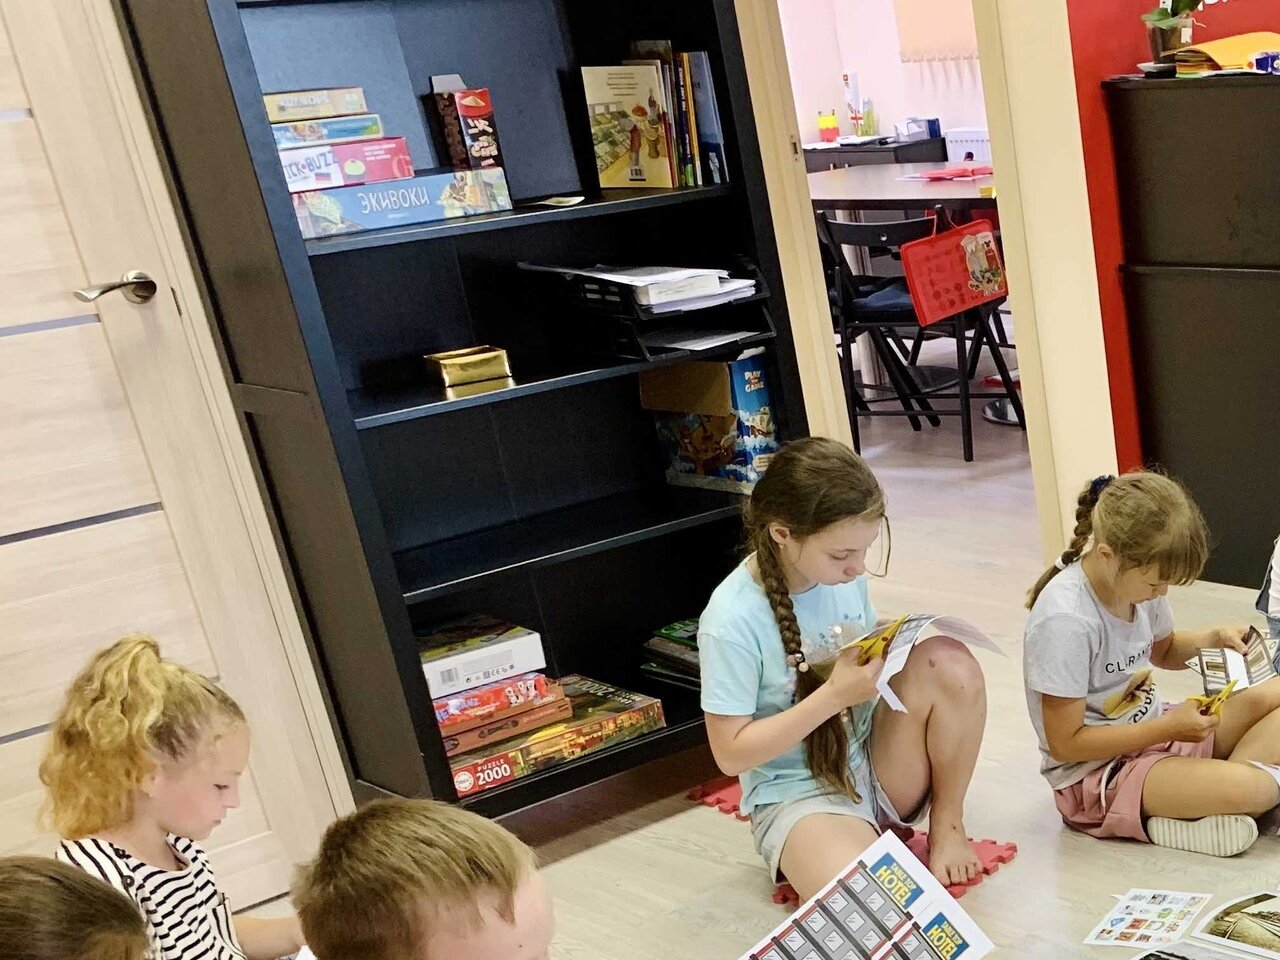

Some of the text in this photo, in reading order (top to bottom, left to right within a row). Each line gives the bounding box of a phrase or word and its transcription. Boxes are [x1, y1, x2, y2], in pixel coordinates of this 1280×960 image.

[357, 186, 431, 215] ЭКИВОКИ
[476, 764, 511, 786] 2000
[477, 758, 505, 772] PUZZLE
[875, 865, 912, 906] HOTEL
[927, 924, 958, 960] HOTEL
